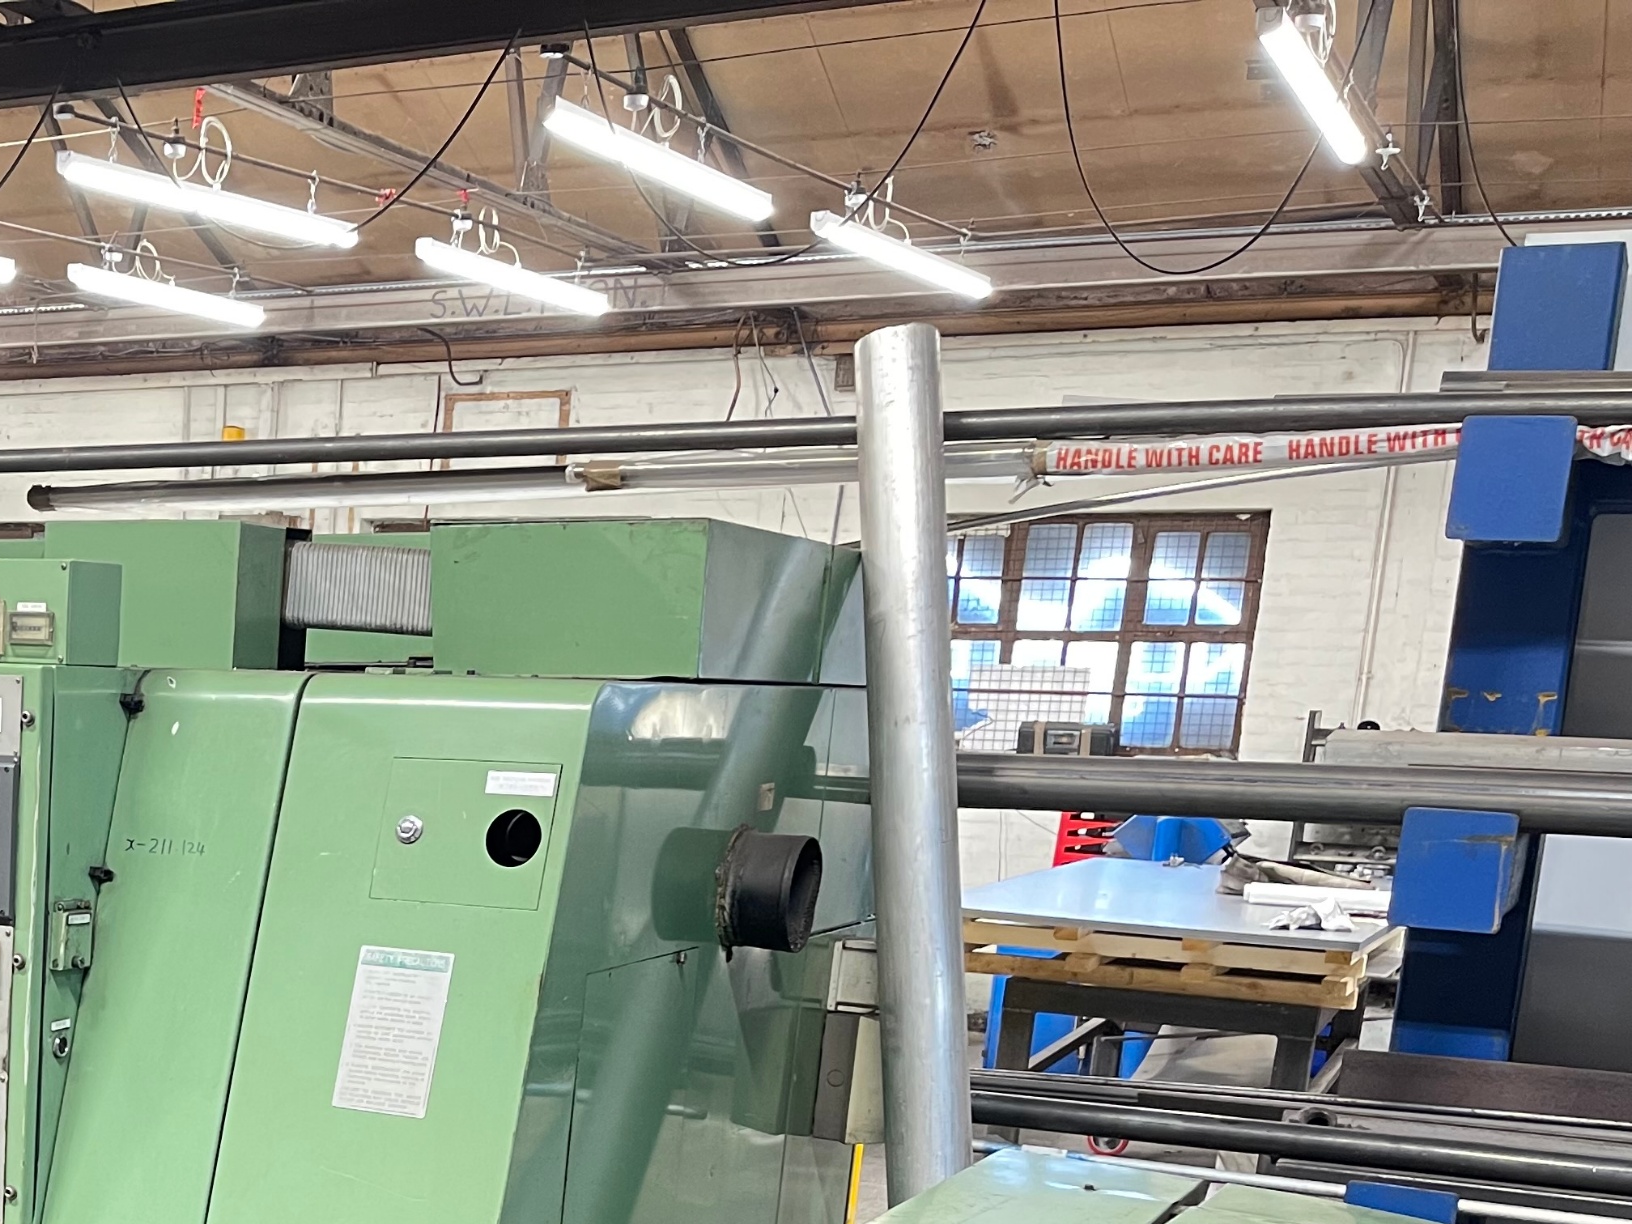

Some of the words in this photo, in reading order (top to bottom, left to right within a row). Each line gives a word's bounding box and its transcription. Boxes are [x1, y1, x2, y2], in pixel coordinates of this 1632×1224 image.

[1056, 444, 1138, 470] HANDLE
[1145, 444, 1200, 469] WITH
[1208, 441, 1264, 466] CARE
[1288, 432, 1378, 461] HANDLE
[1386, 428, 1447, 453] WITH
